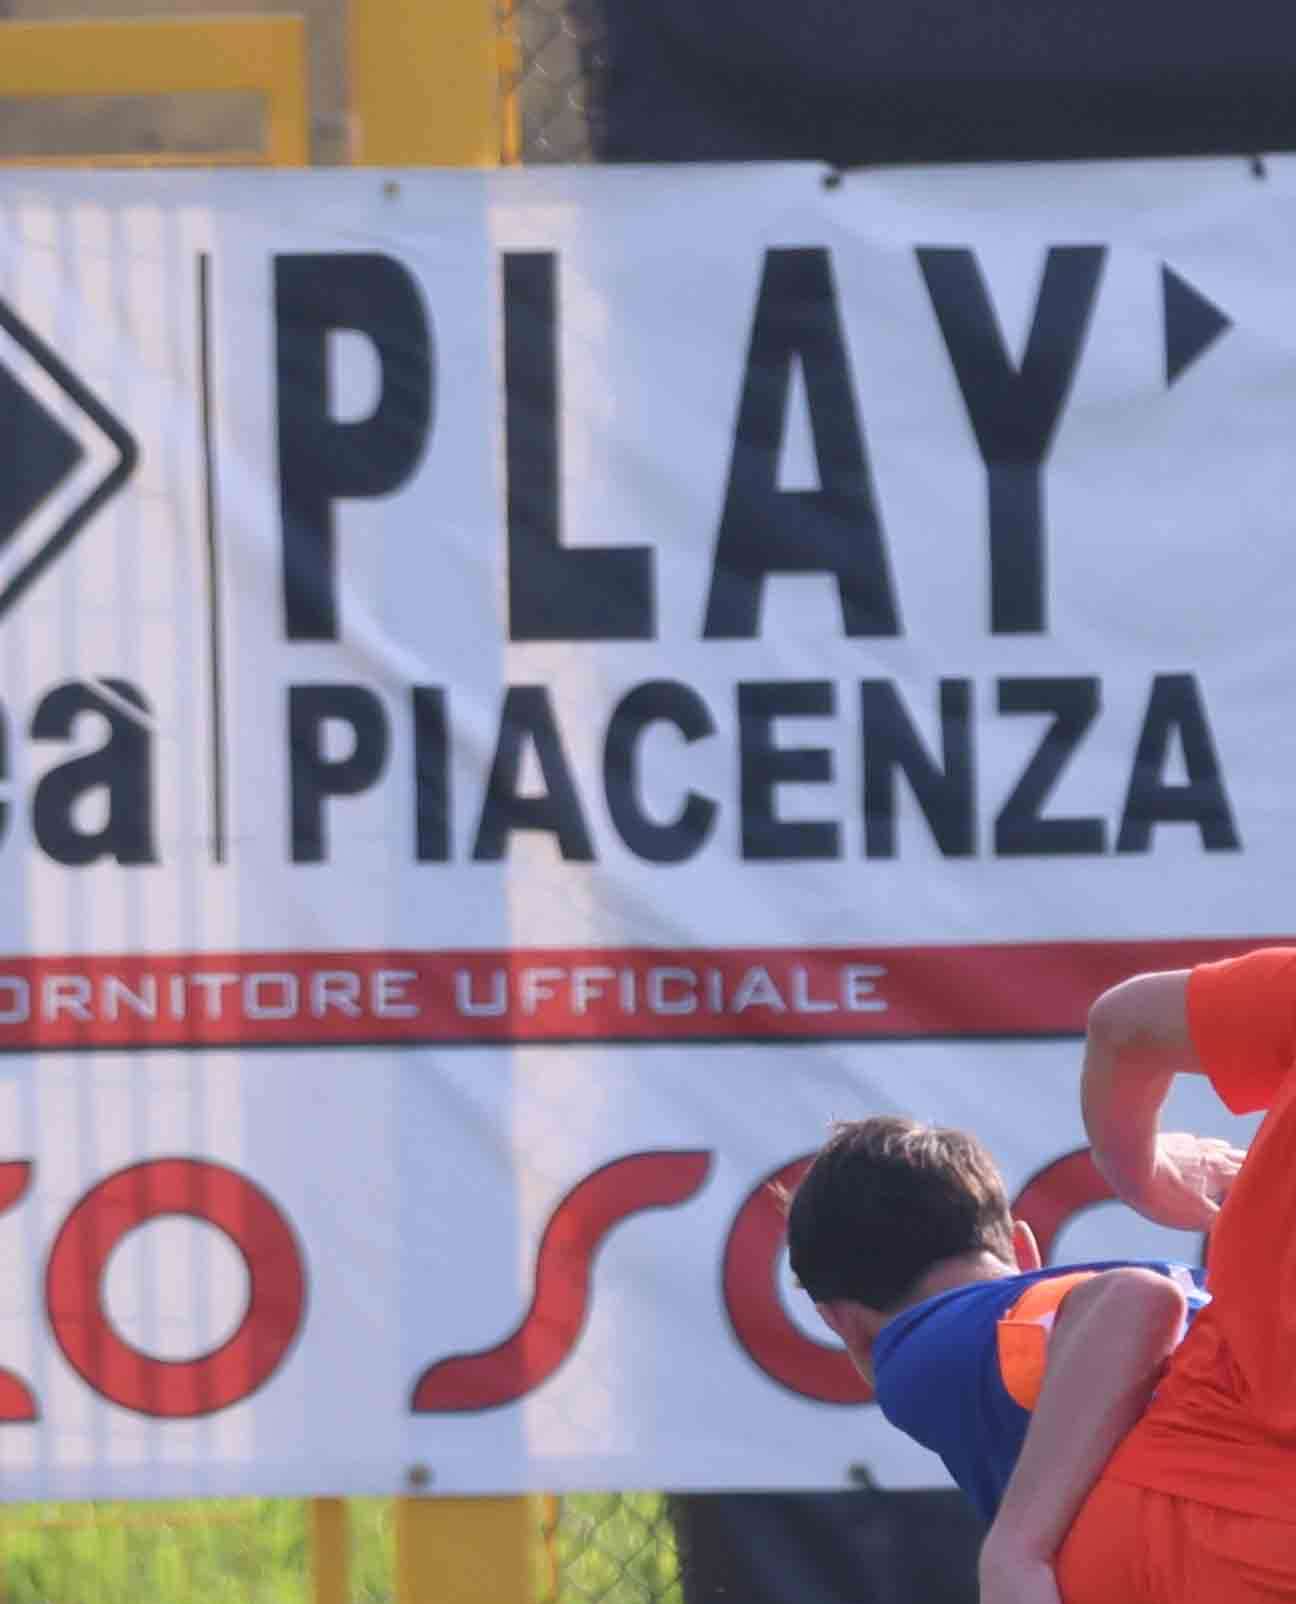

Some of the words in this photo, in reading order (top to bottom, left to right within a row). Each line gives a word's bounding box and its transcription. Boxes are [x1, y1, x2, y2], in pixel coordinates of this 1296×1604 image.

[271, 243, 1109, 643] PLAY
[285, 671, 1244, 868] PIACENZA
[455, 964, 889, 1018] UFFICIALE
